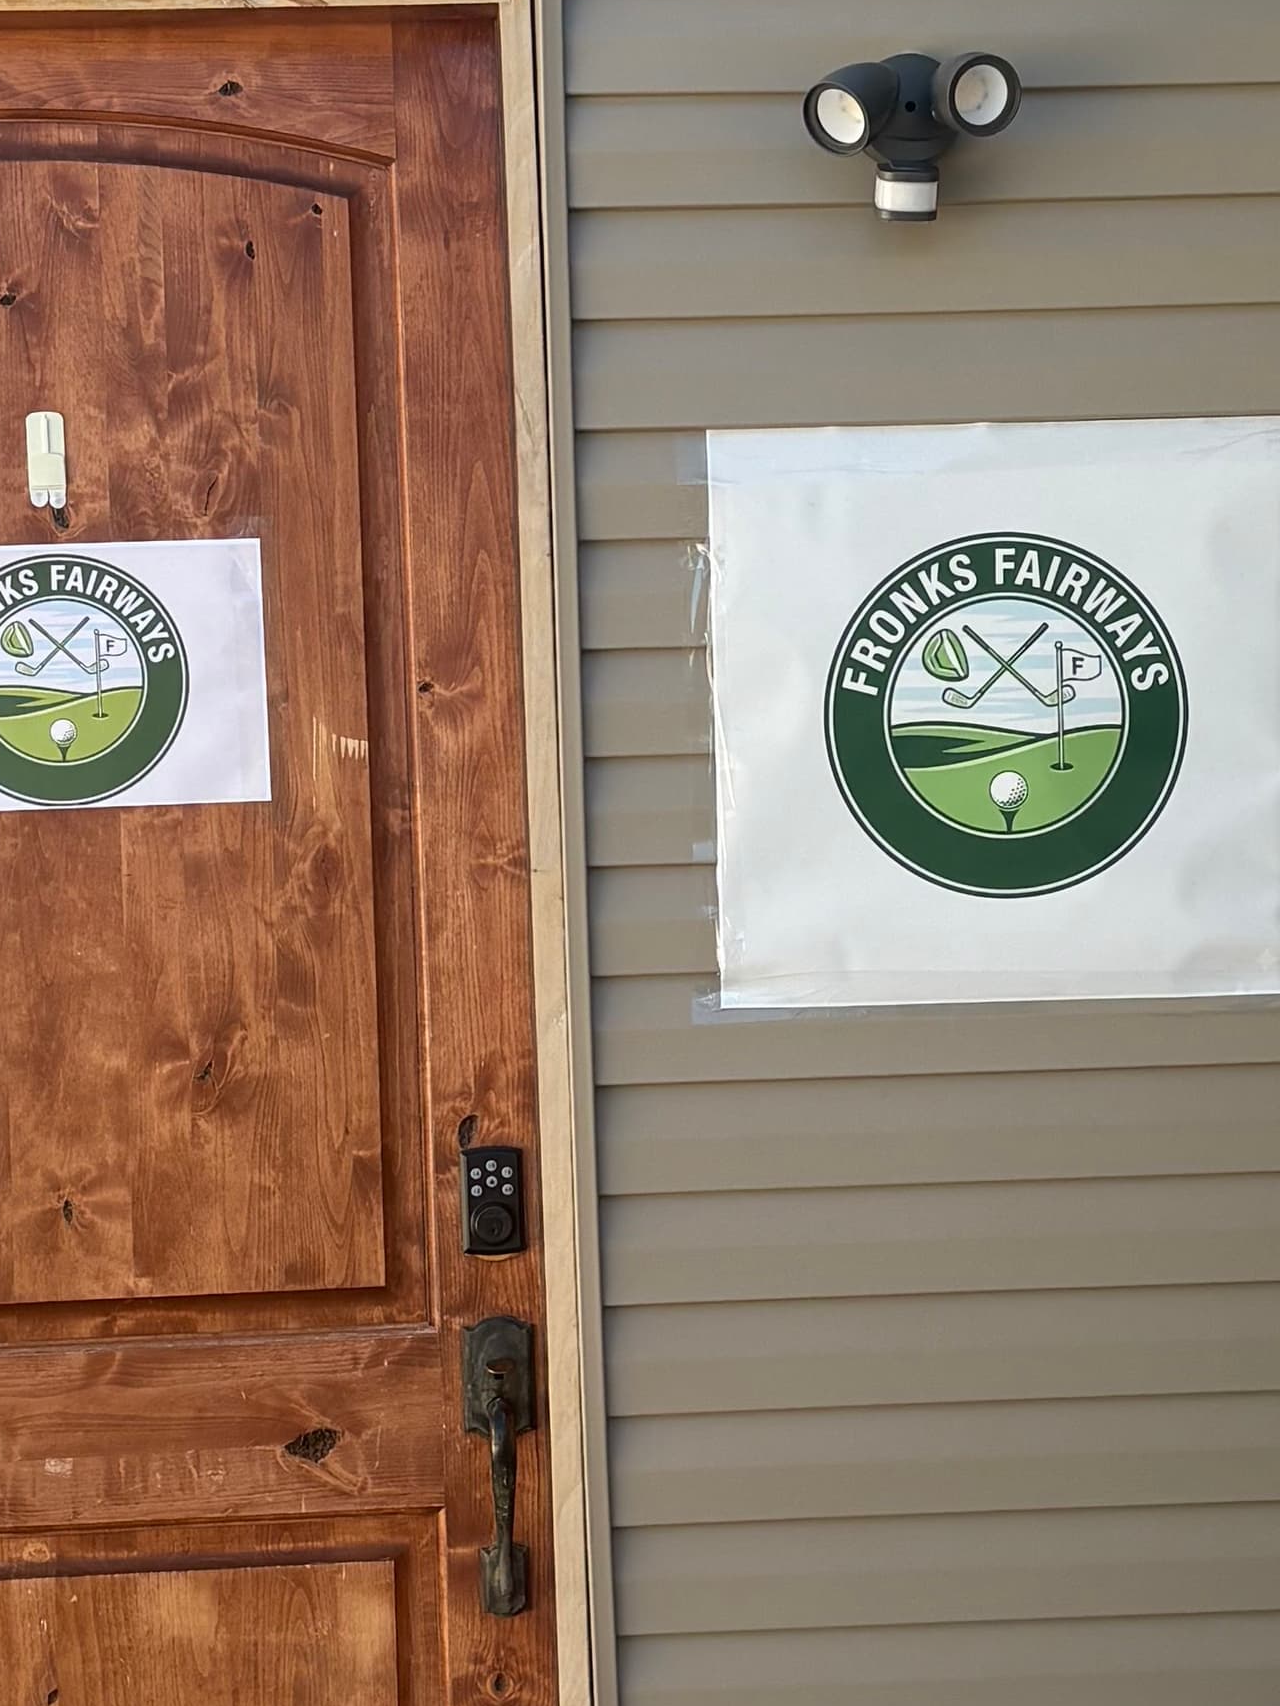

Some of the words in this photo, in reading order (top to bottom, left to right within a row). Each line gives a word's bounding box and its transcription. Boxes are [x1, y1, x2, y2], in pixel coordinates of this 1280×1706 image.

[50, 565, 176, 664] FAIRWAYS
[842, 554, 978, 696] FRONKS
[994, 548, 1170, 692] FAIRWAYS
[106, 639, 116, 653] F
[1071, 656, 1085, 676] F
